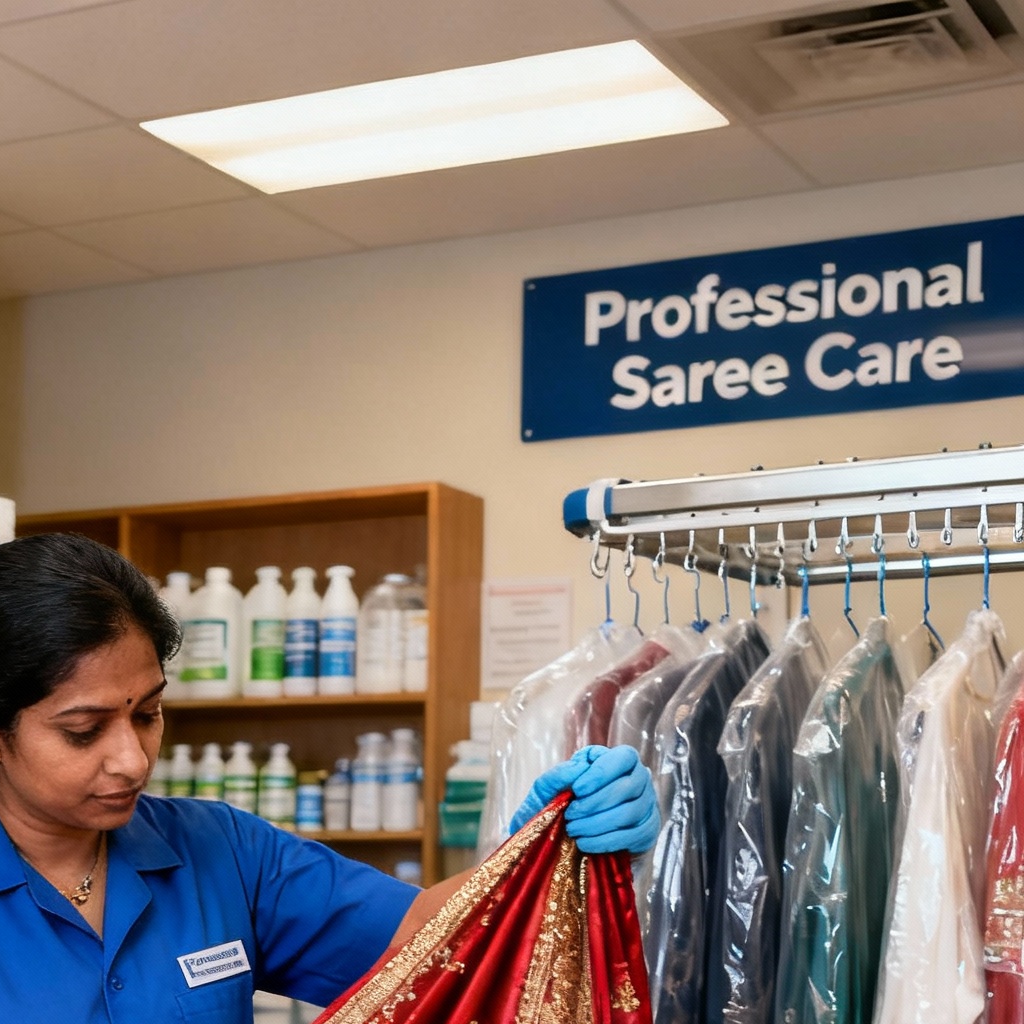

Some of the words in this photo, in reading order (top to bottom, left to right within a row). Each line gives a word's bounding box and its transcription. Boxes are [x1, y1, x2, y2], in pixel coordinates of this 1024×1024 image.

[584, 241, 984, 346] Professional
[610, 354, 789, 410] Saree
[805, 331, 964, 391] Care
